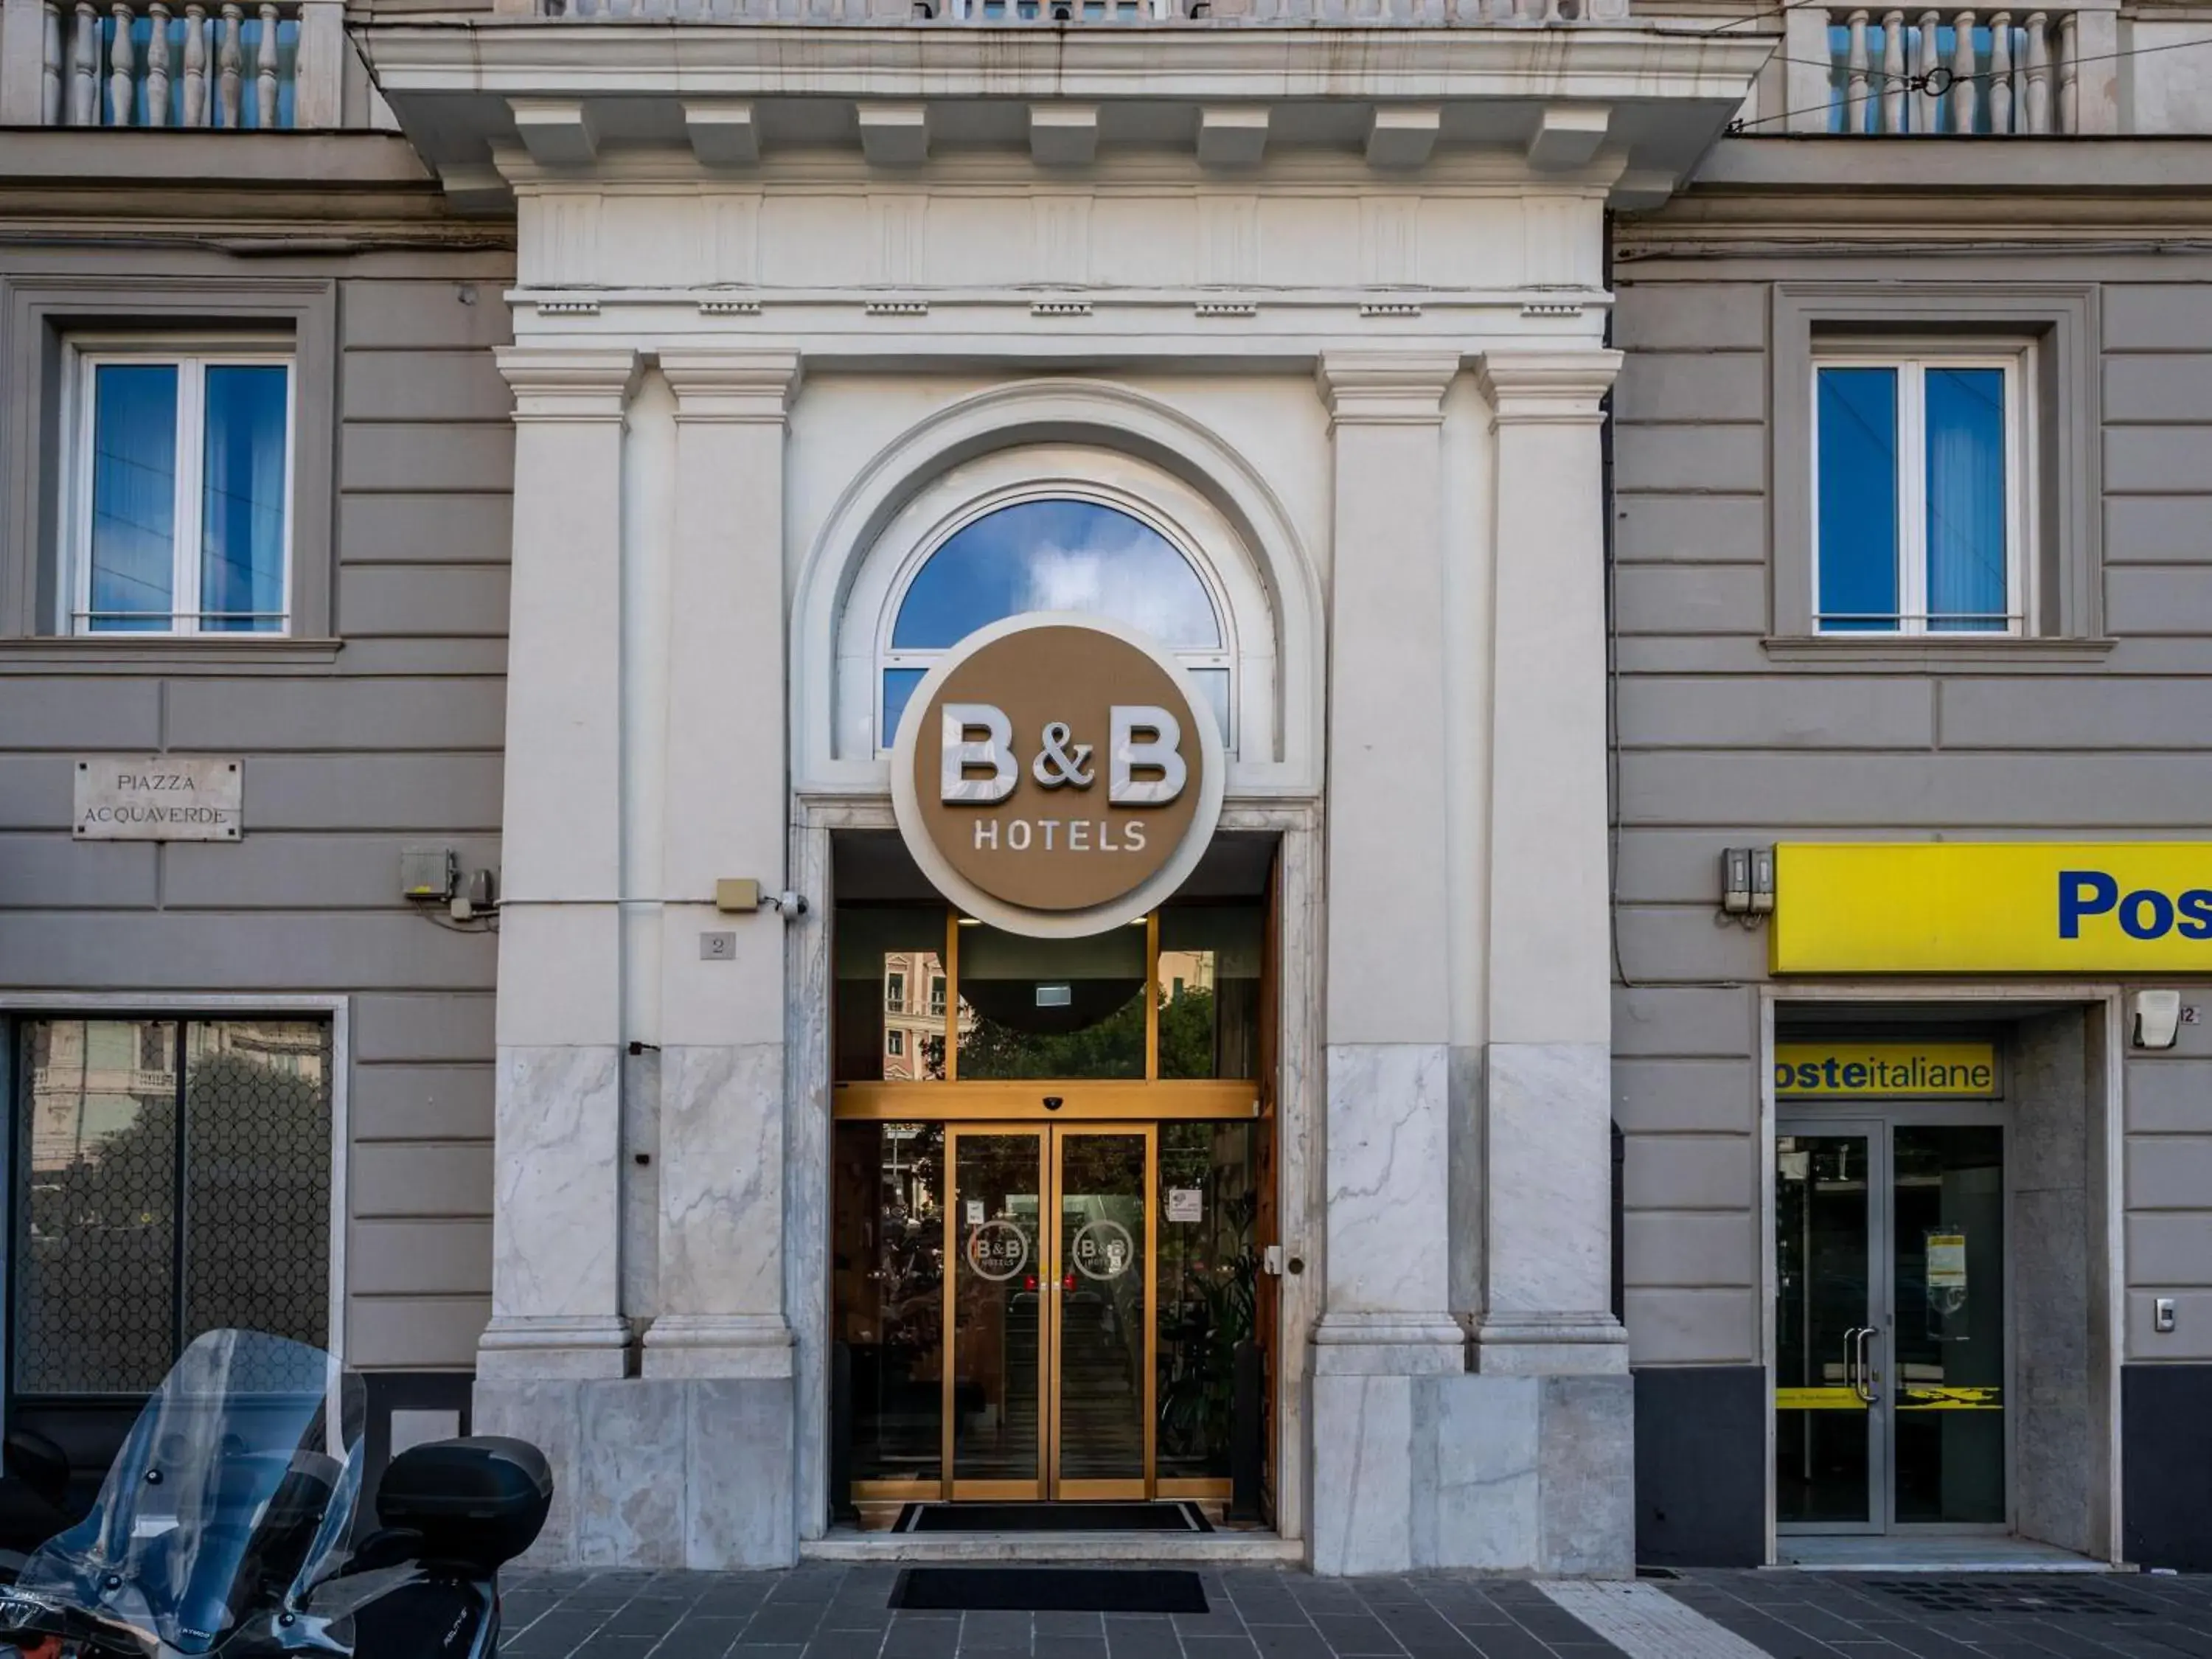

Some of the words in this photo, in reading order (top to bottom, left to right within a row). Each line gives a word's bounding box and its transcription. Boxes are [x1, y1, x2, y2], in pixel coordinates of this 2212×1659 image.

[941, 703, 1186, 805] B&B
[117, 775, 195, 790] PIAZZA
[85, 807, 227, 824] ACQUAVERDE
[974, 819, 1147, 852] HOTELS
[977, 1240, 1020, 1257] B&B
